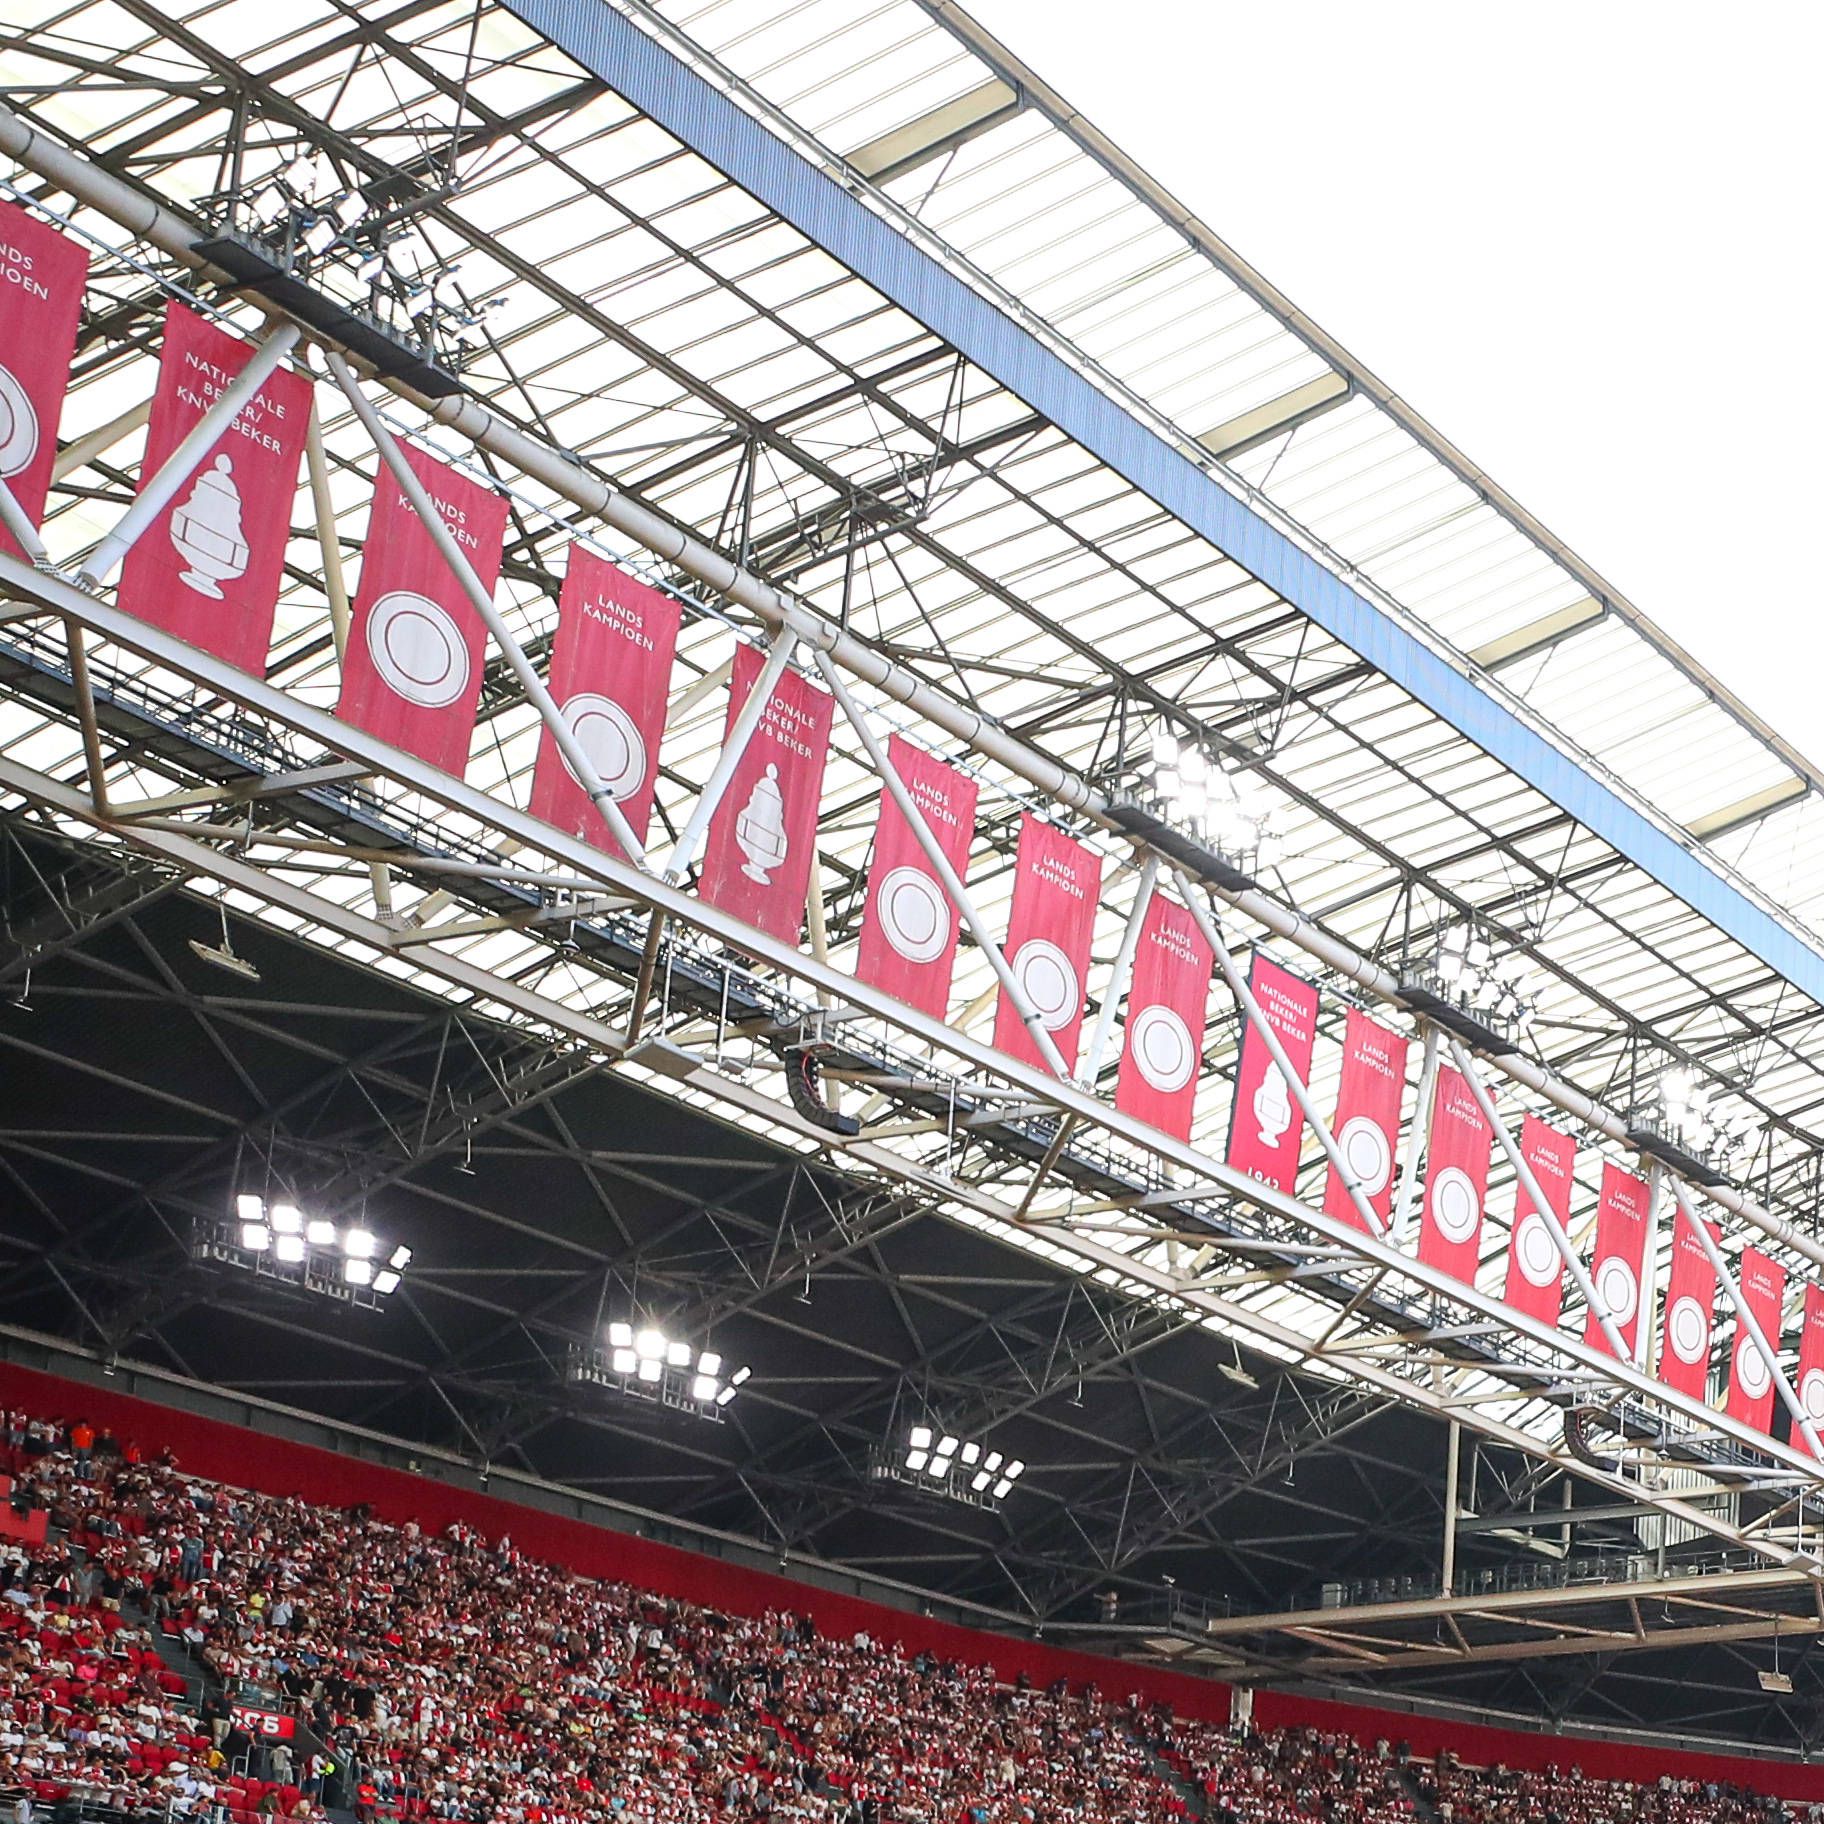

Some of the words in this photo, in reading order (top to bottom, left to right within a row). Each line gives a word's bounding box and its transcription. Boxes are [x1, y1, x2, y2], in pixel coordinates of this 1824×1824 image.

[0, 262, 48, 300] IOEN
[231, 415, 282, 455] BEKER
[420, 491, 466, 524] ANDS
[598, 594, 643, 629] LANDS
[583, 602, 653, 651] KAMPIOEN
[776, 734, 814, 760] BEKER
[912, 777, 949, 806] LANDS
[904, 789, 958, 827] AMPIOEN
[1031, 863, 1084, 900] KAMPIOEN
[1042, 855, 1076, 881] LANDS
[1150, 932, 1200, 966] KAMPIOEN
[1160, 924, 1191, 948] LANDS
[1260, 982, 1308, 1018] NATIONALE
[1282, 1021, 1307, 1043] BEKER
[1353, 1051, 1395, 1080] KAMPIOEN
[1363, 1042, 1389, 1064] LANDS
[1445, 1104, 1482, 1130] KAMPIOEN
[1454, 1096, 1477, 1116] LANDS
[1529, 1152, 1565, 1178] KAMPIOEN
[1536, 1144, 1560, 1165] LANDS
[1607, 1198, 1640, 1222] KAMPIOEN
[1614, 1190, 1636, 1208] LANDS
